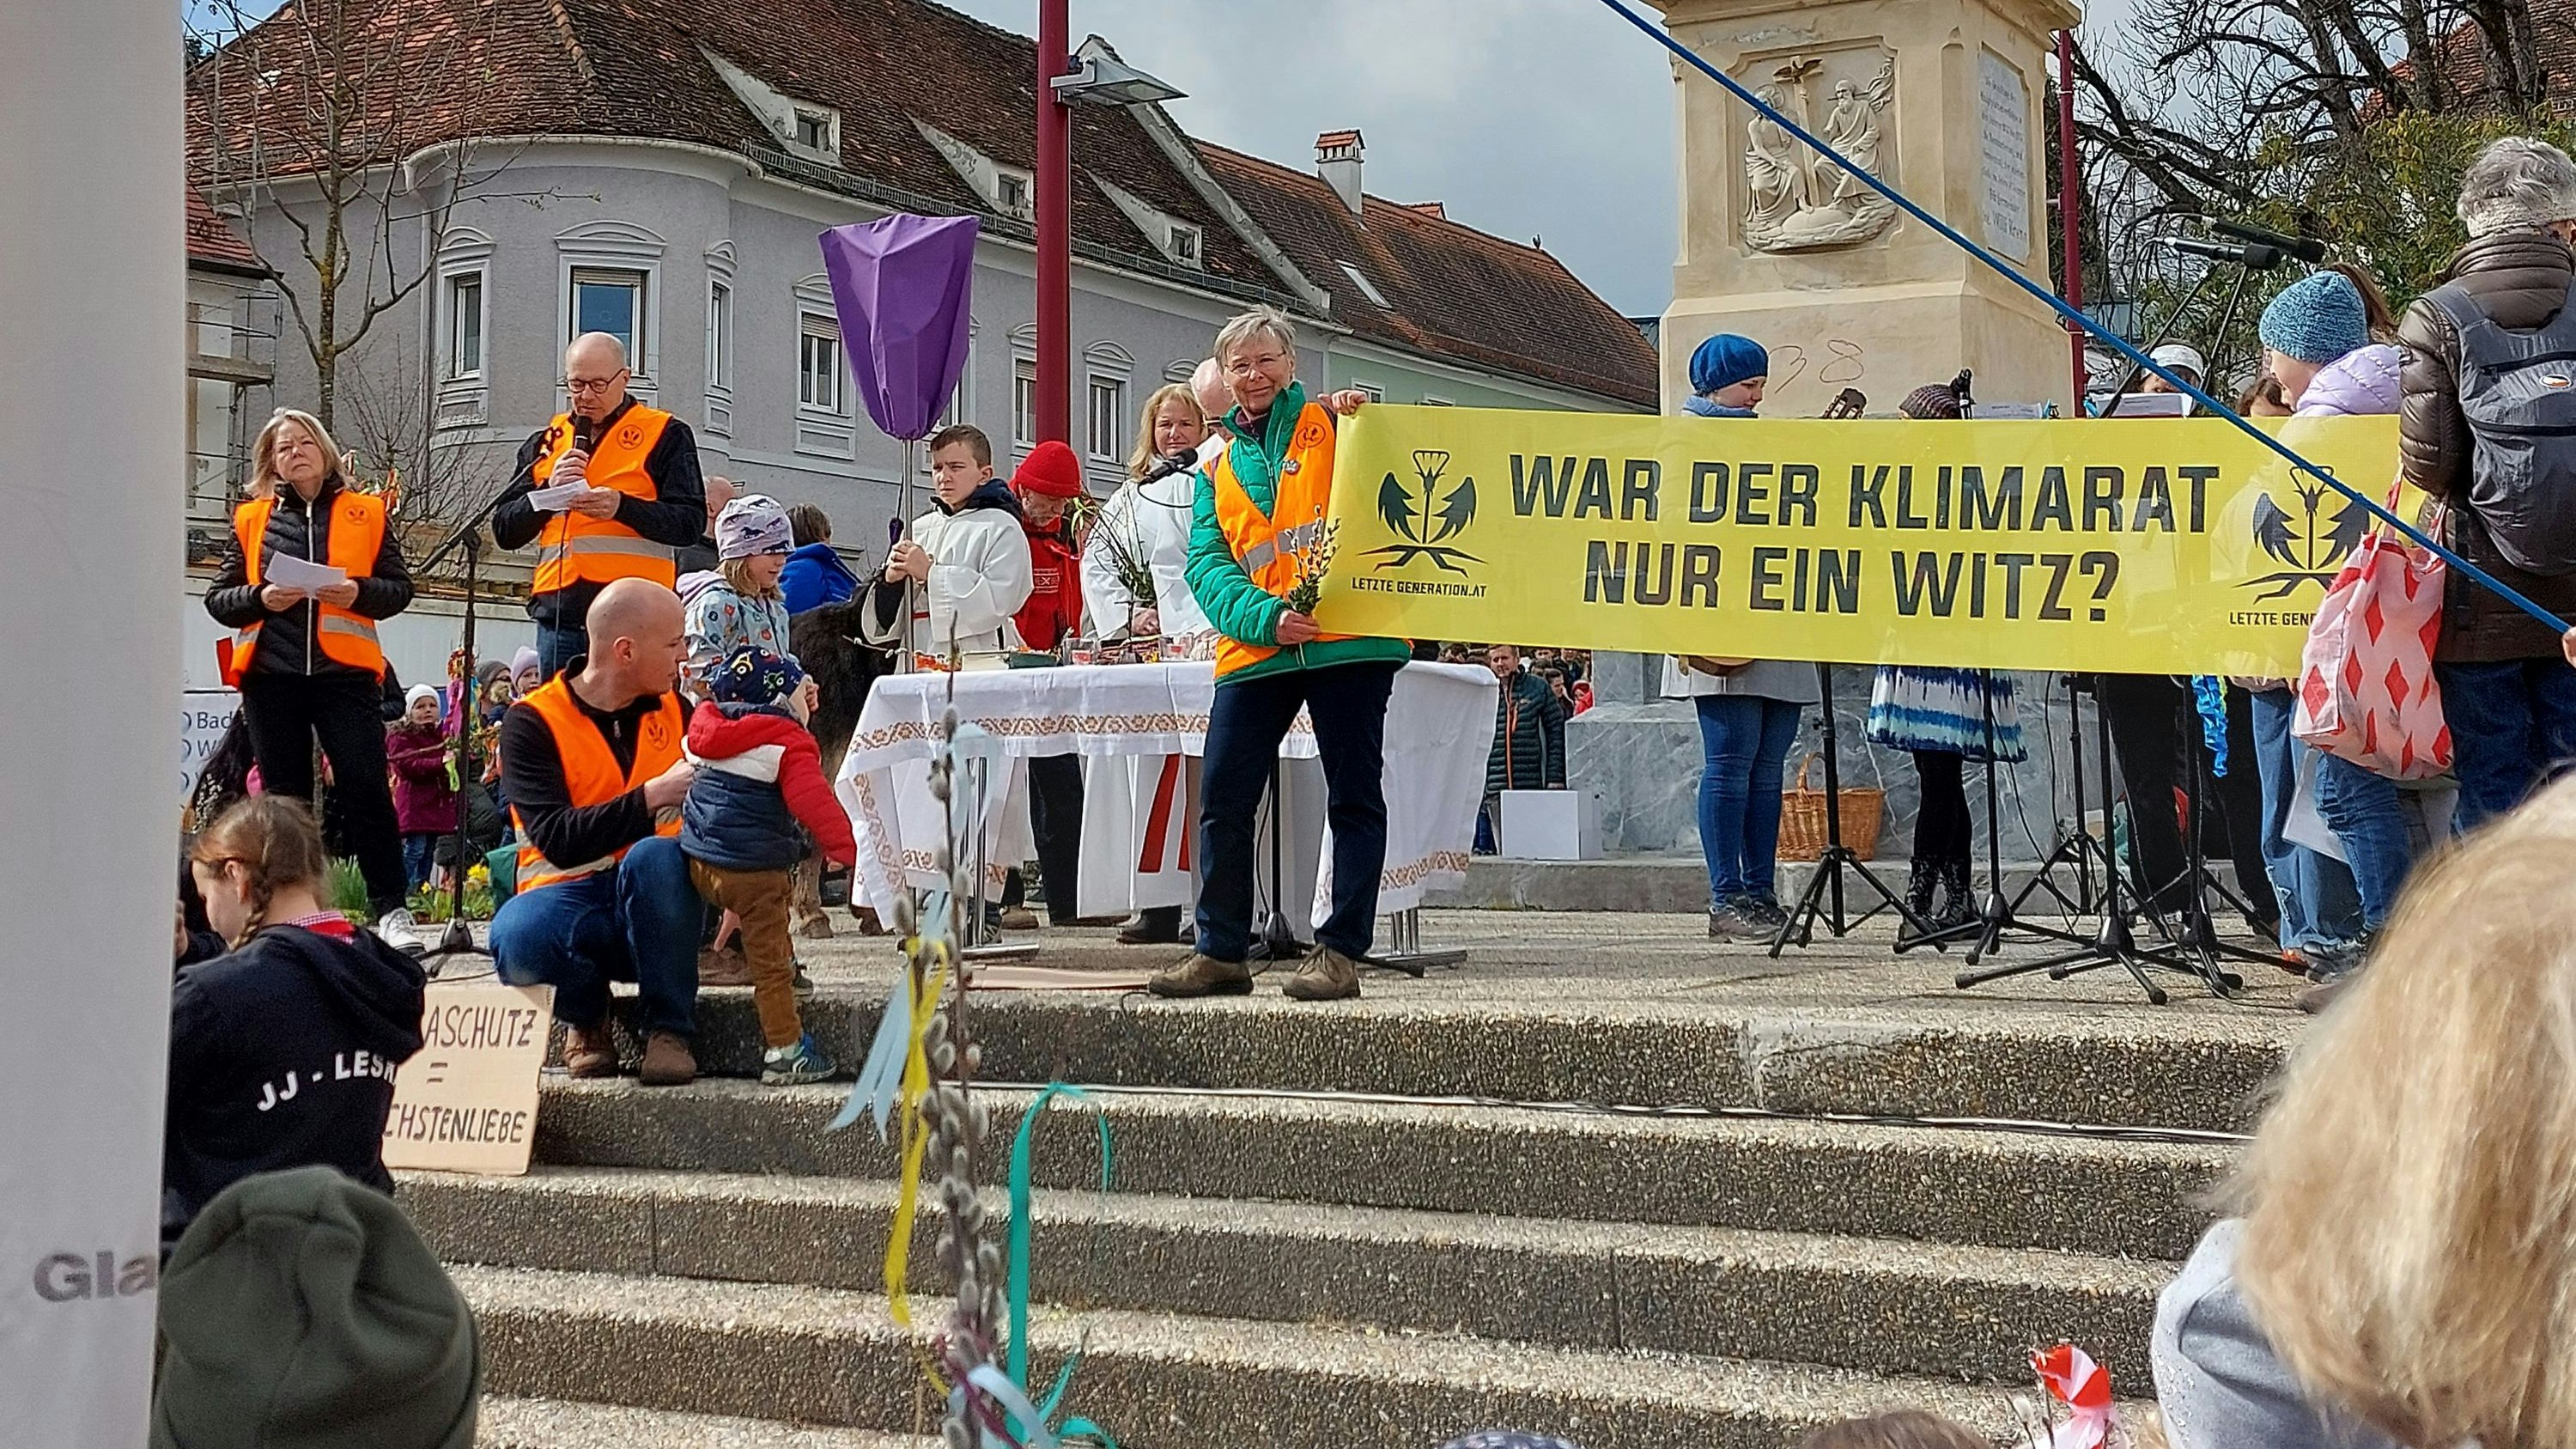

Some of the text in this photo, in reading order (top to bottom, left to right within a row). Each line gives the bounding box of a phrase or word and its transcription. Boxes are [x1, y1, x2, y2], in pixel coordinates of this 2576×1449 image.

[1509, 454, 2221, 533] WAR DER KLIMARAT
[1352, 576, 1488, 599] LETZTE GENERATION.AT
[1583, 539, 2121, 622] NUR EIN WITZ?
[2229, 611, 2278, 626] LETZTE
[257, 1070, 299, 1111] JJ
